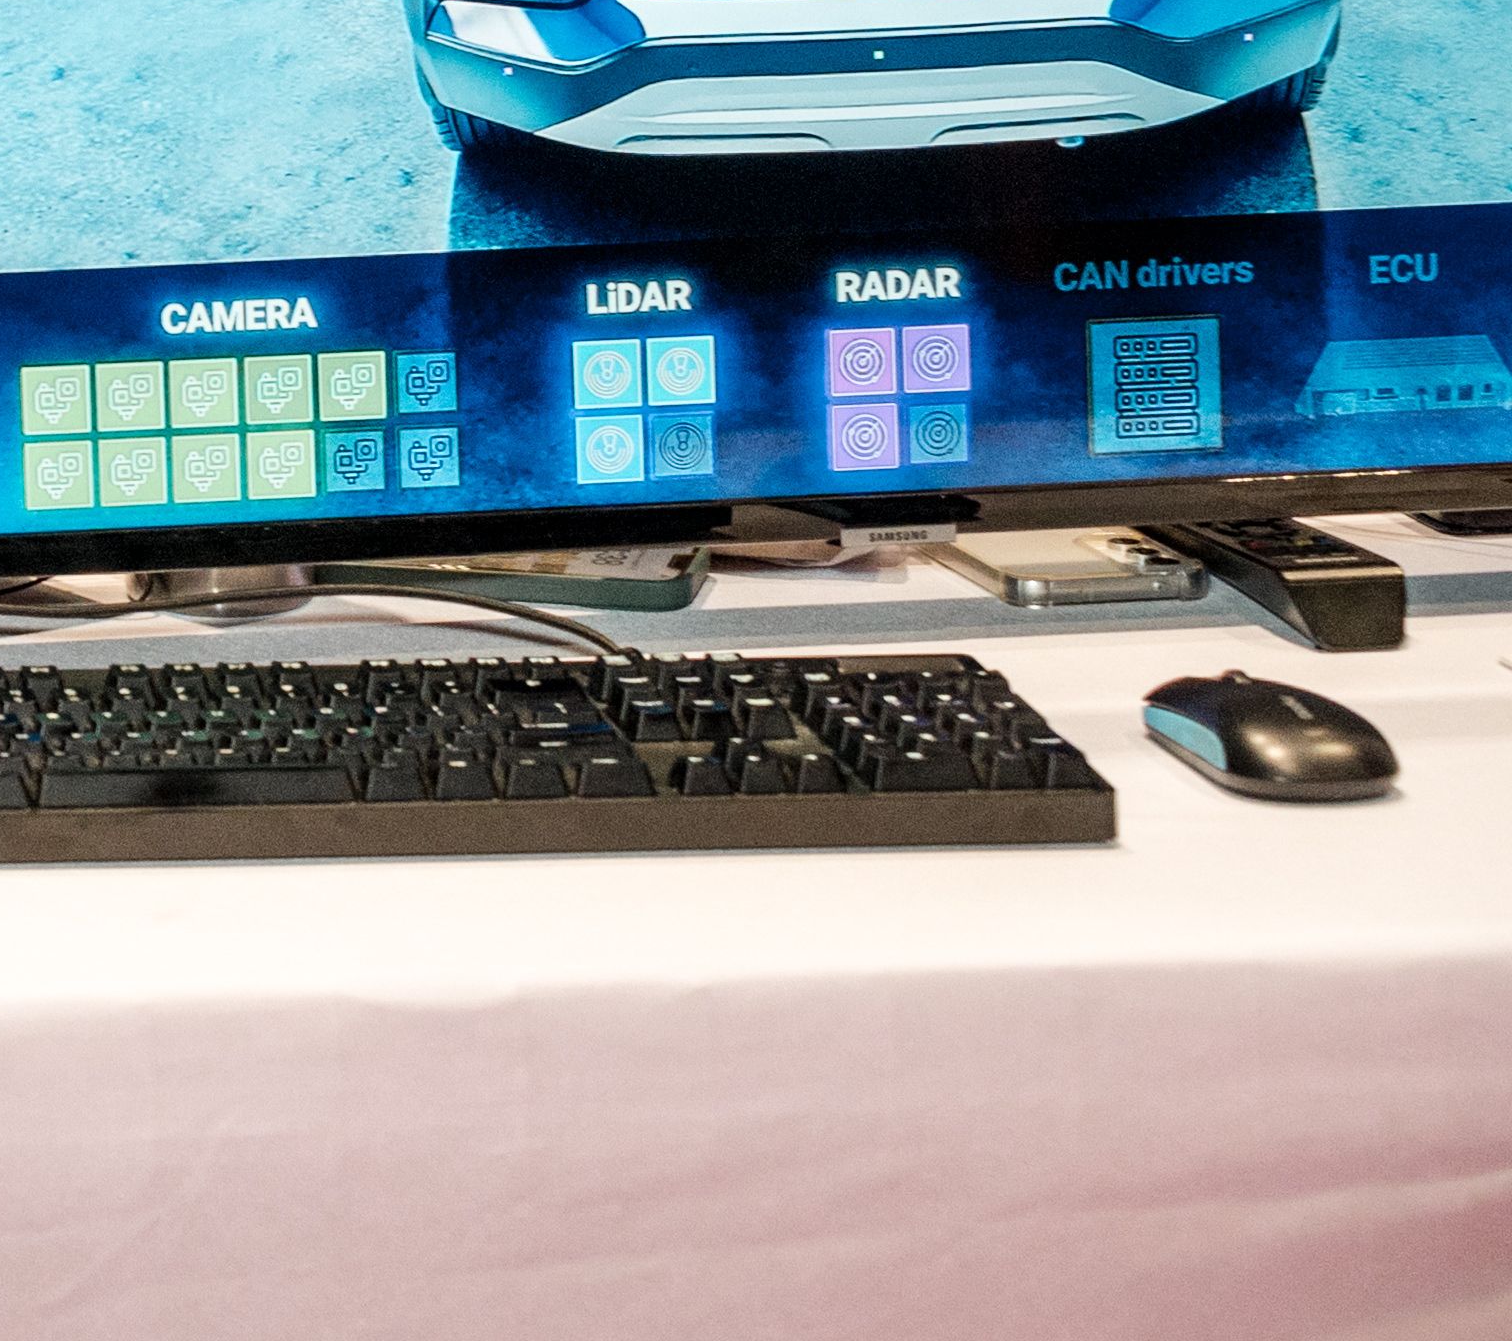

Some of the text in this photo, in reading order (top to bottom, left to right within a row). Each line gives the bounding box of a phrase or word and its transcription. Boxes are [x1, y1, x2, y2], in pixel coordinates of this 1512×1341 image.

[160, 253, 1439, 334] CAMERA LiDAR RADAR CAN drivers ECU
[869, 530, 928, 542] SAMSUNG
